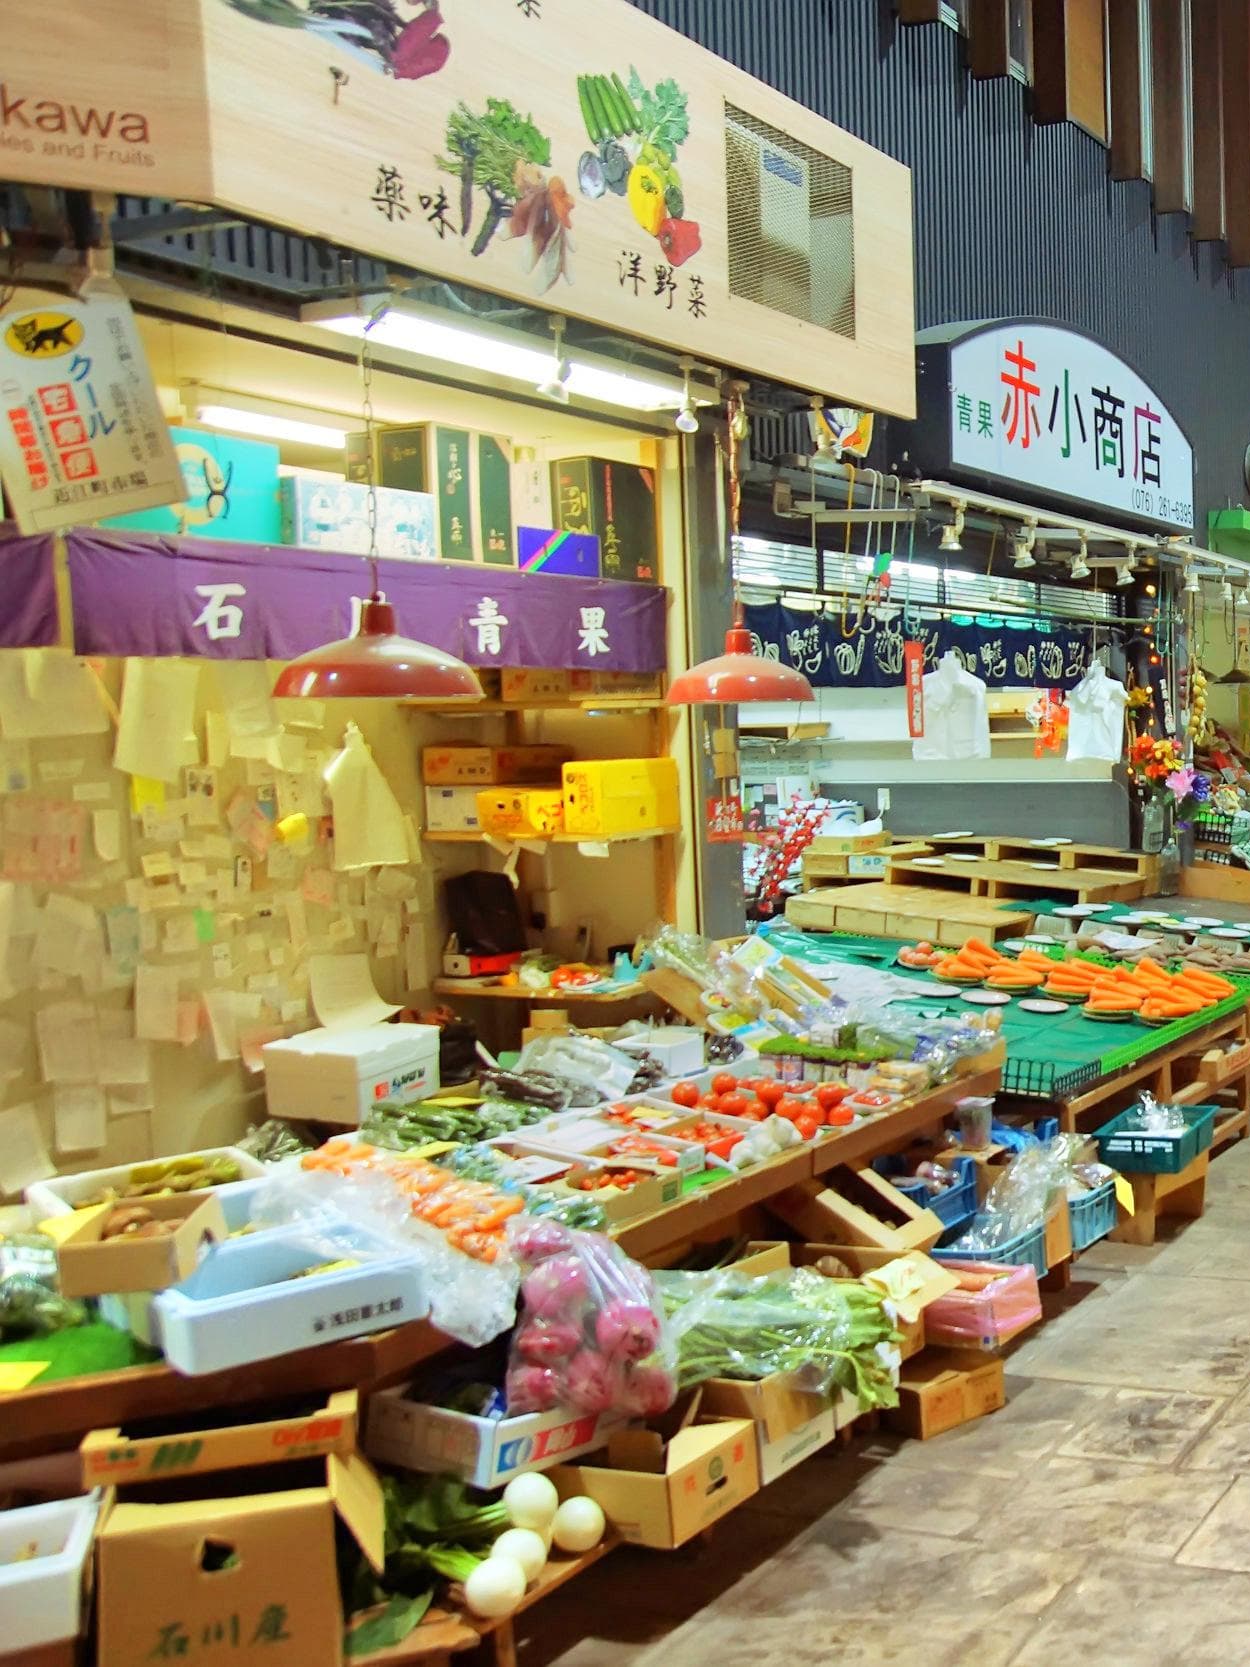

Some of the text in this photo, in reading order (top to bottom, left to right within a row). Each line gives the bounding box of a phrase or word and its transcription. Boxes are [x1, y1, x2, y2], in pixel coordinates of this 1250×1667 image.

[0, 83, 150, 144] kawa
[95, 143, 156, 167] Fruits
[371, 164, 458, 240] 薬味
[618, 250, 708, 319] 洋野菜
[68, 353, 117, 440] クール
[956, 393, 994, 440] 青果
[1000, 340, 1162, 488] 赤小商店
[1131, 487, 1193, 525] (076) 261-6395
